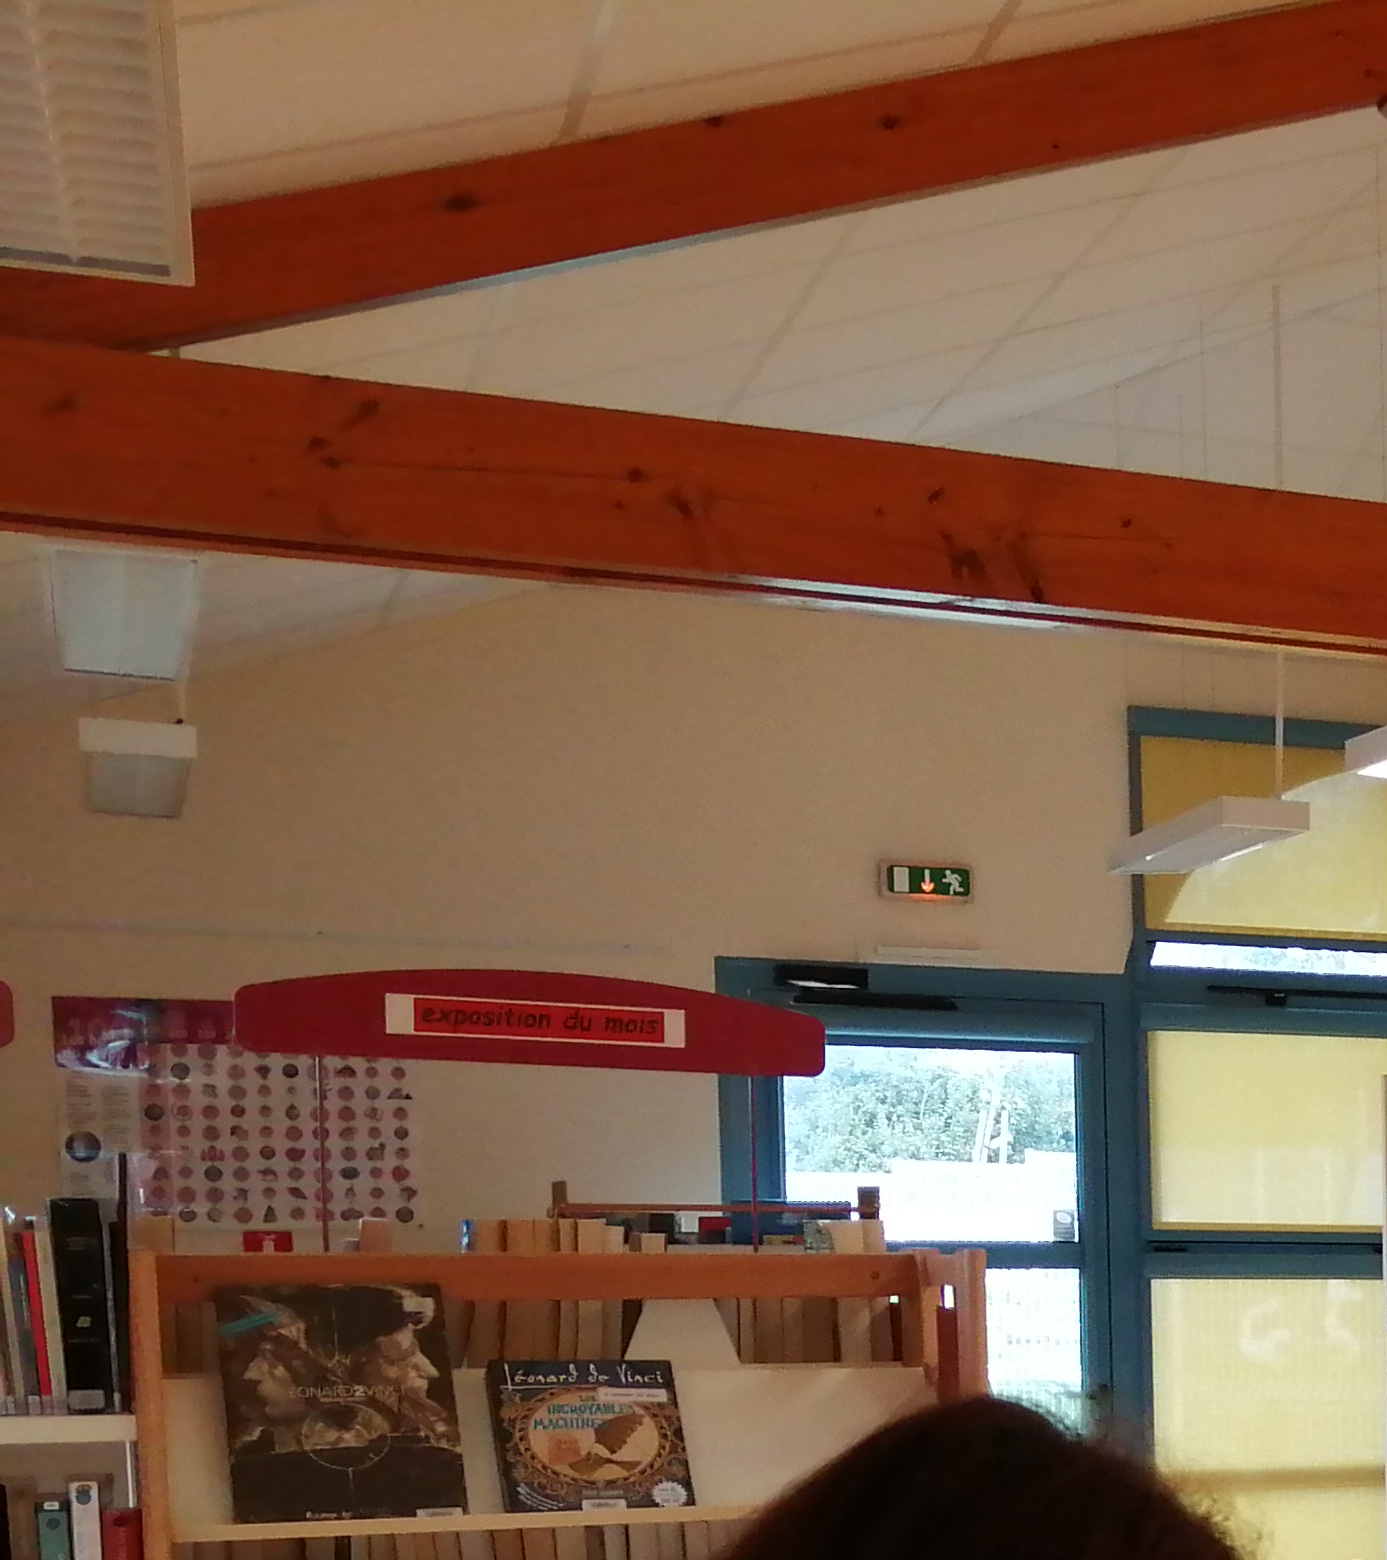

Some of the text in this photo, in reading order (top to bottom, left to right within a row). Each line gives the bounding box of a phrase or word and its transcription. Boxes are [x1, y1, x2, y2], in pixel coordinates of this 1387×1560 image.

[421, 1005, 659, 1035] exposition du mois
[503, 1363, 664, 1391] Léonard de Vinci
